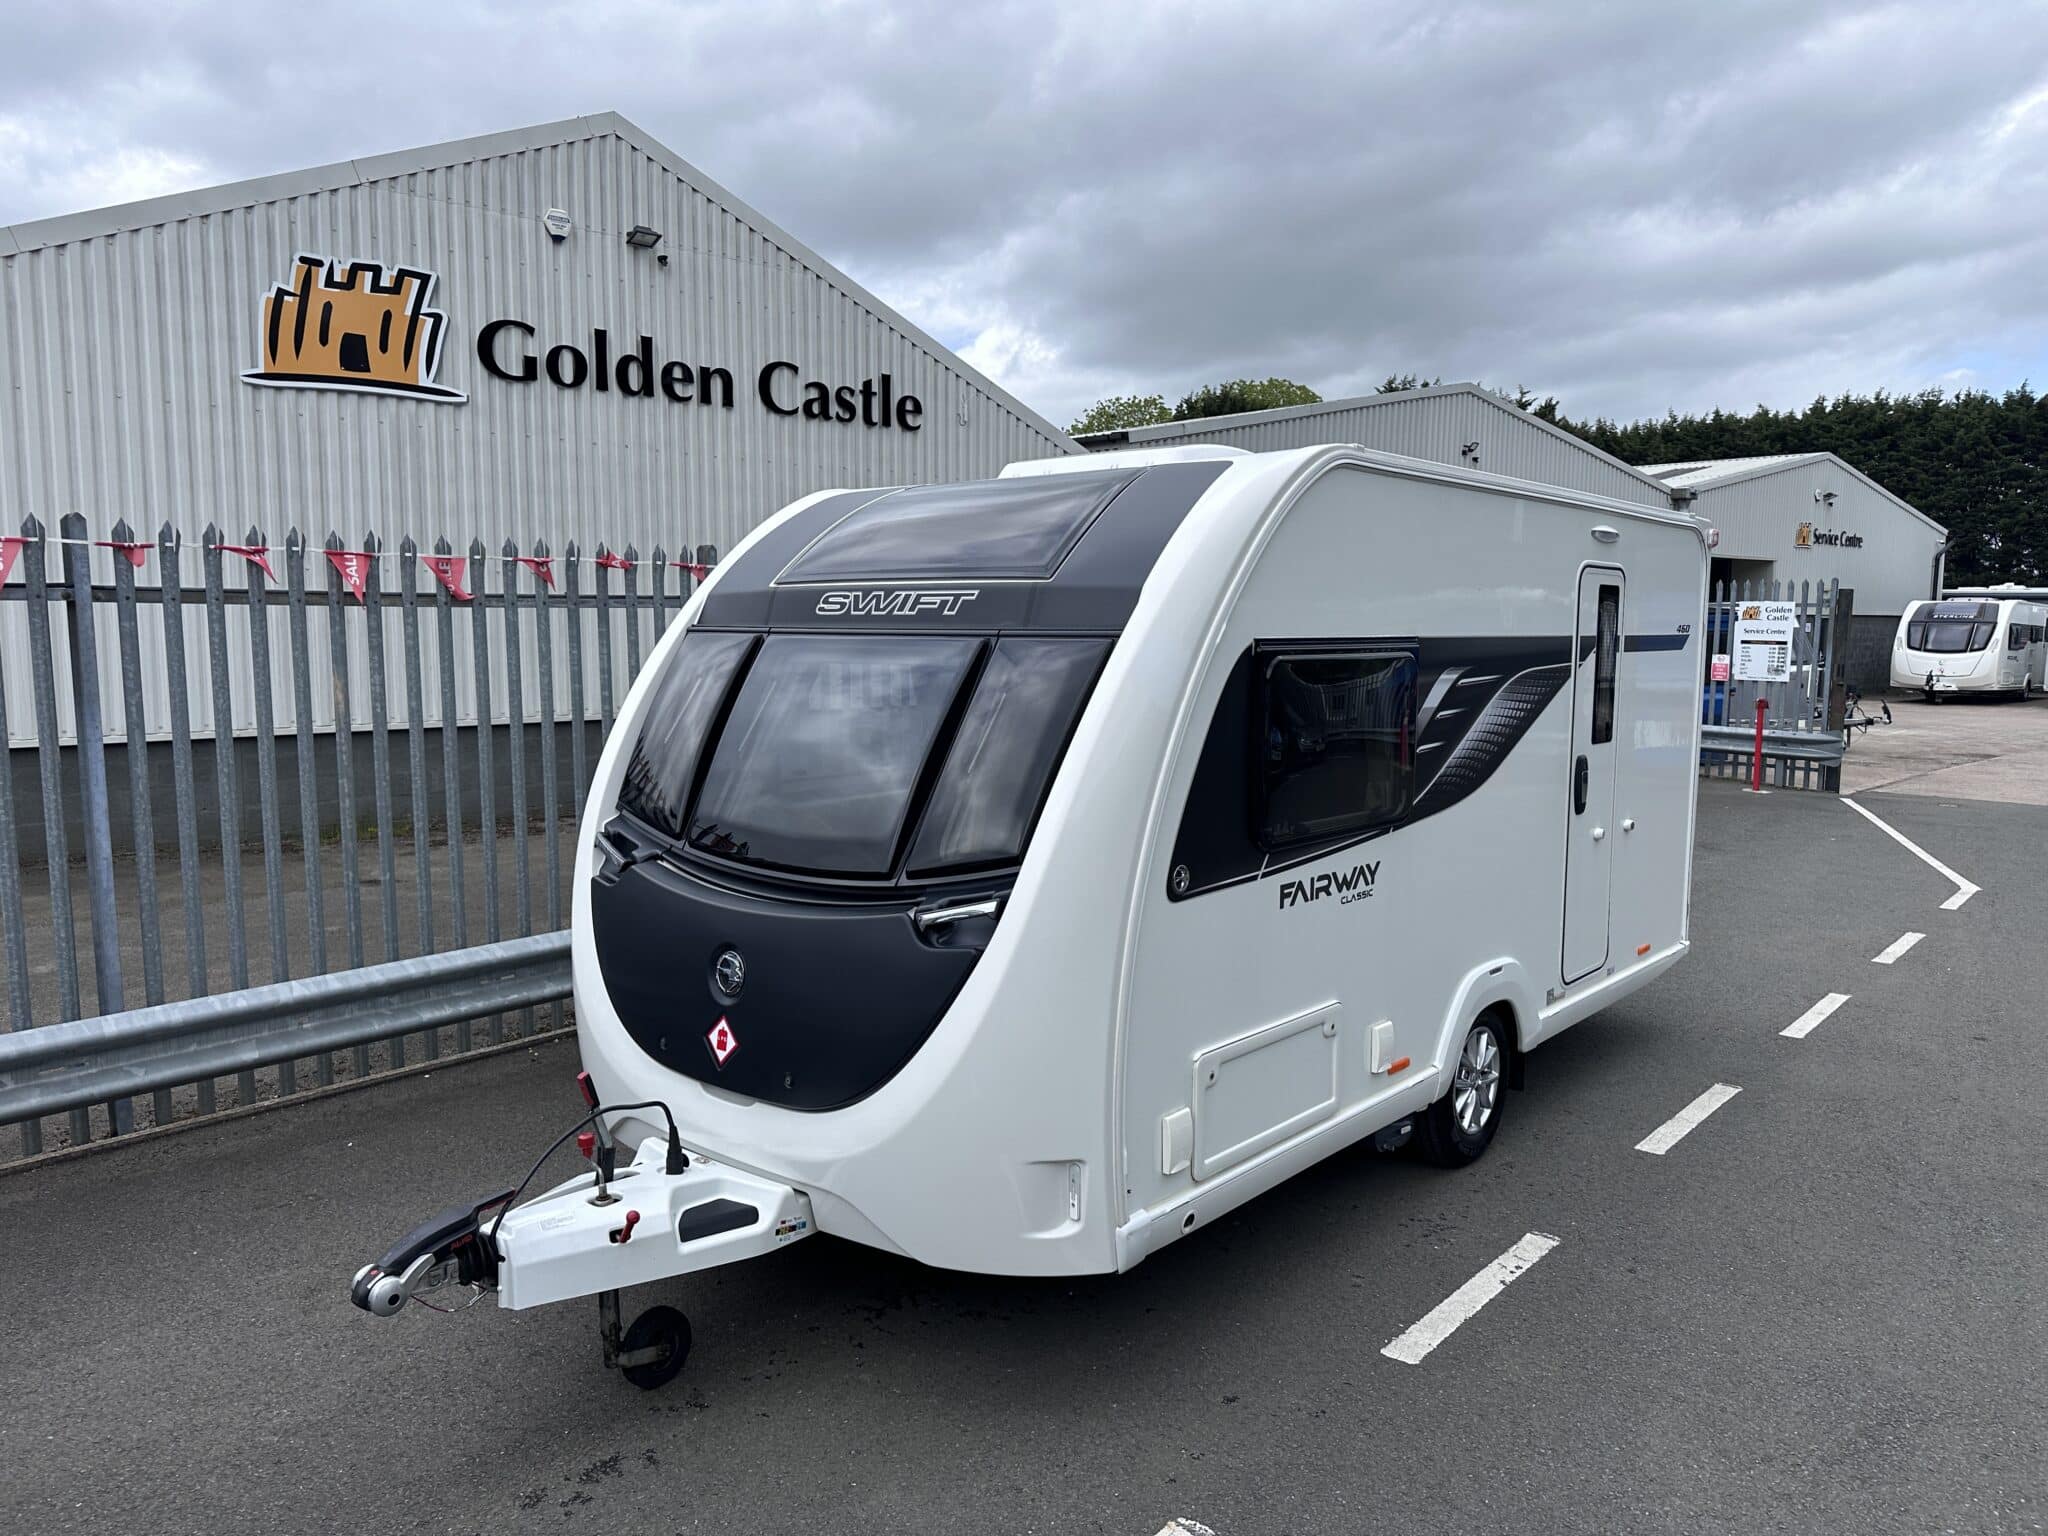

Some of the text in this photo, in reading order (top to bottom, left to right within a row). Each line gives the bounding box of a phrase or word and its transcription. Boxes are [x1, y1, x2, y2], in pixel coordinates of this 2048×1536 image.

[477, 319, 923, 431] Golden Castle
[1813, 528, 1863, 548] Service Centre
[816, 590, 980, 615] SWIFT
[1765, 605, 1793, 614] Golden
[1279, 860, 1381, 910] FAIRWAY
[1340, 889, 1374, 905] CLASSIC
